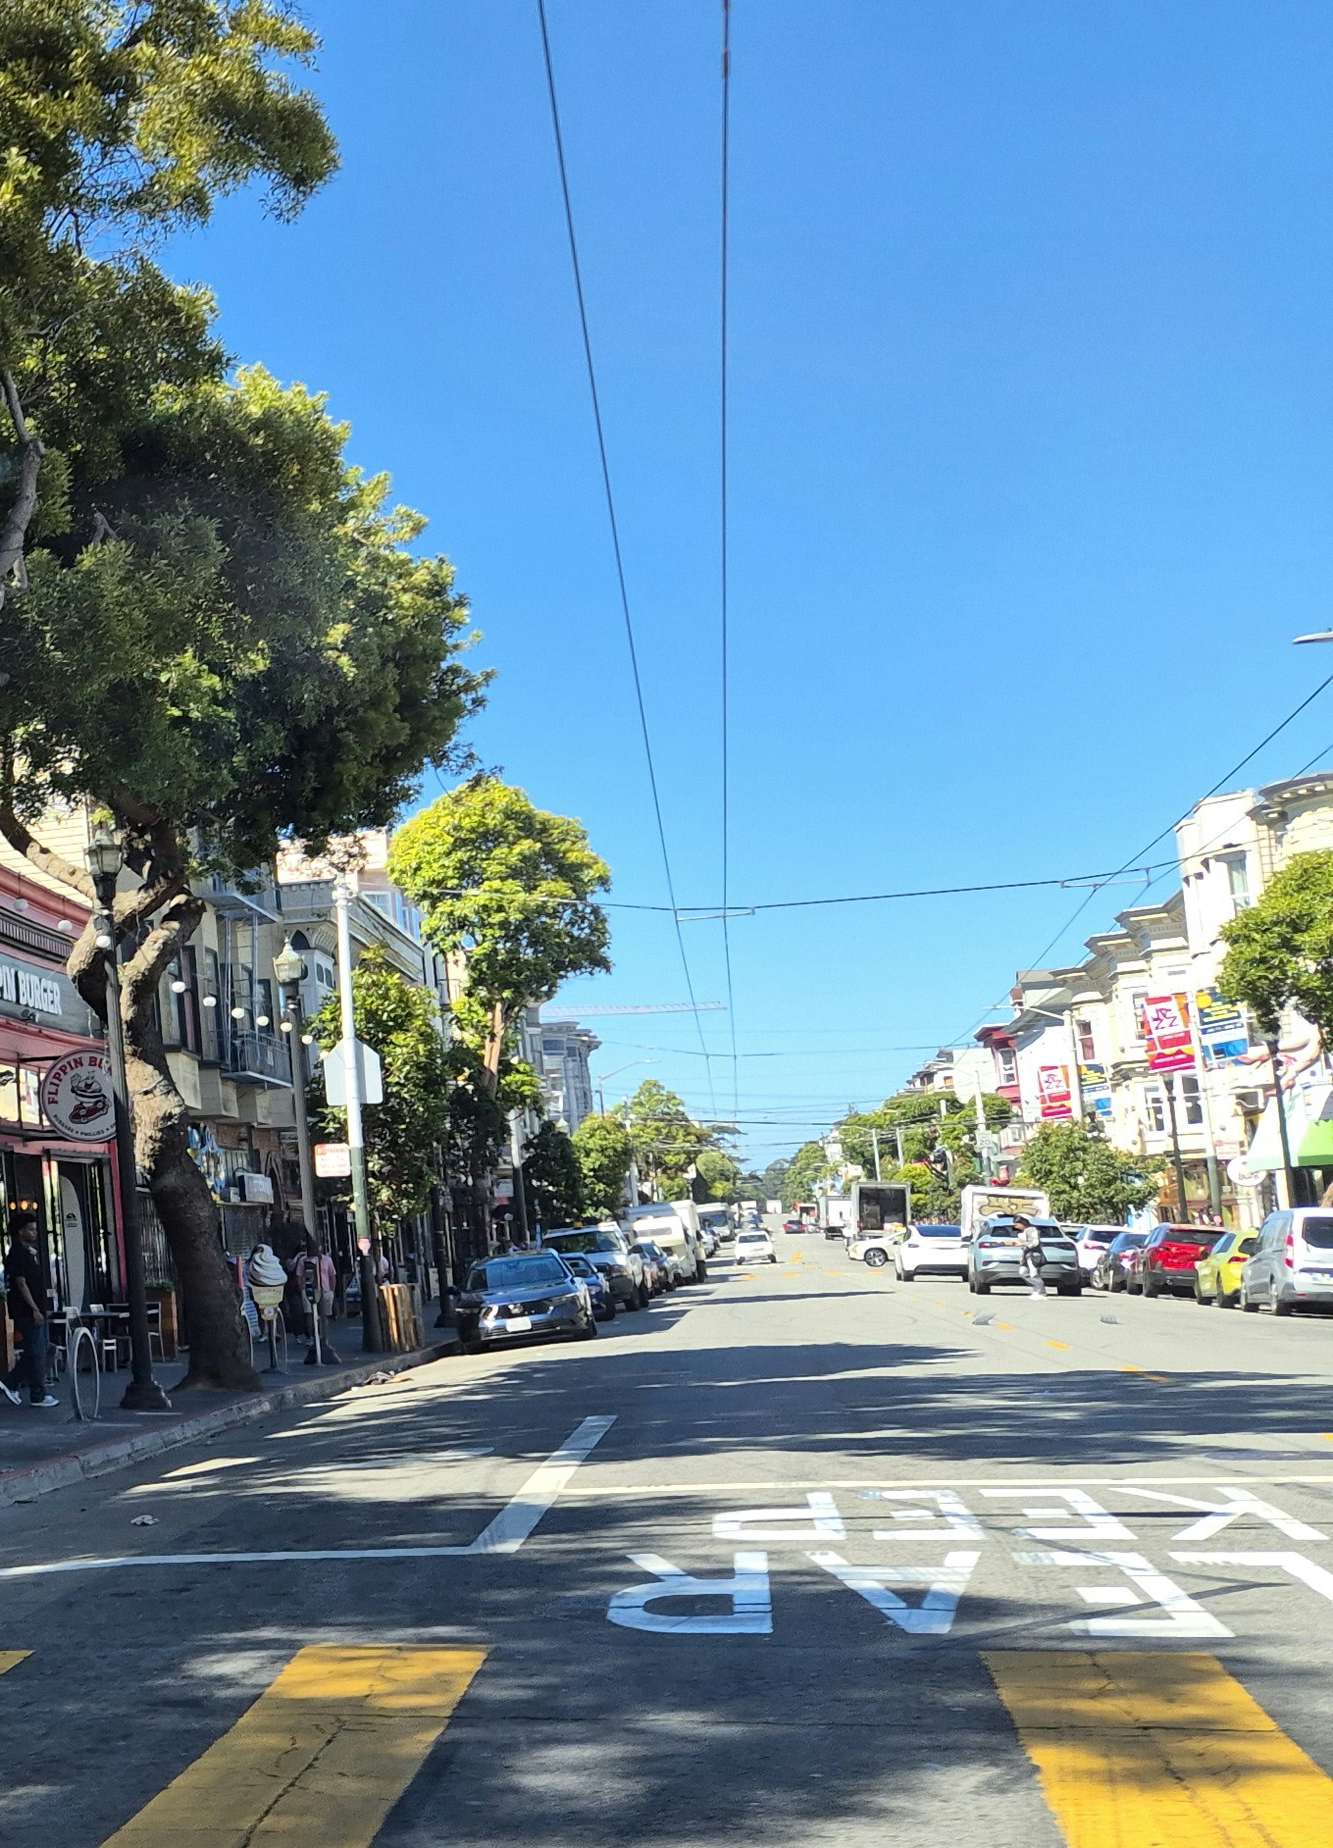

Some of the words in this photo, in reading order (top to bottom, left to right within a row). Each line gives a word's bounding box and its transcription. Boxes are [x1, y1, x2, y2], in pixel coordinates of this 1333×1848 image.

[17, 970, 63, 1015] BURGER
[47, 1056, 84, 1105] FLIPPIN
[712, 1487, 1331, 1541] KEEP
